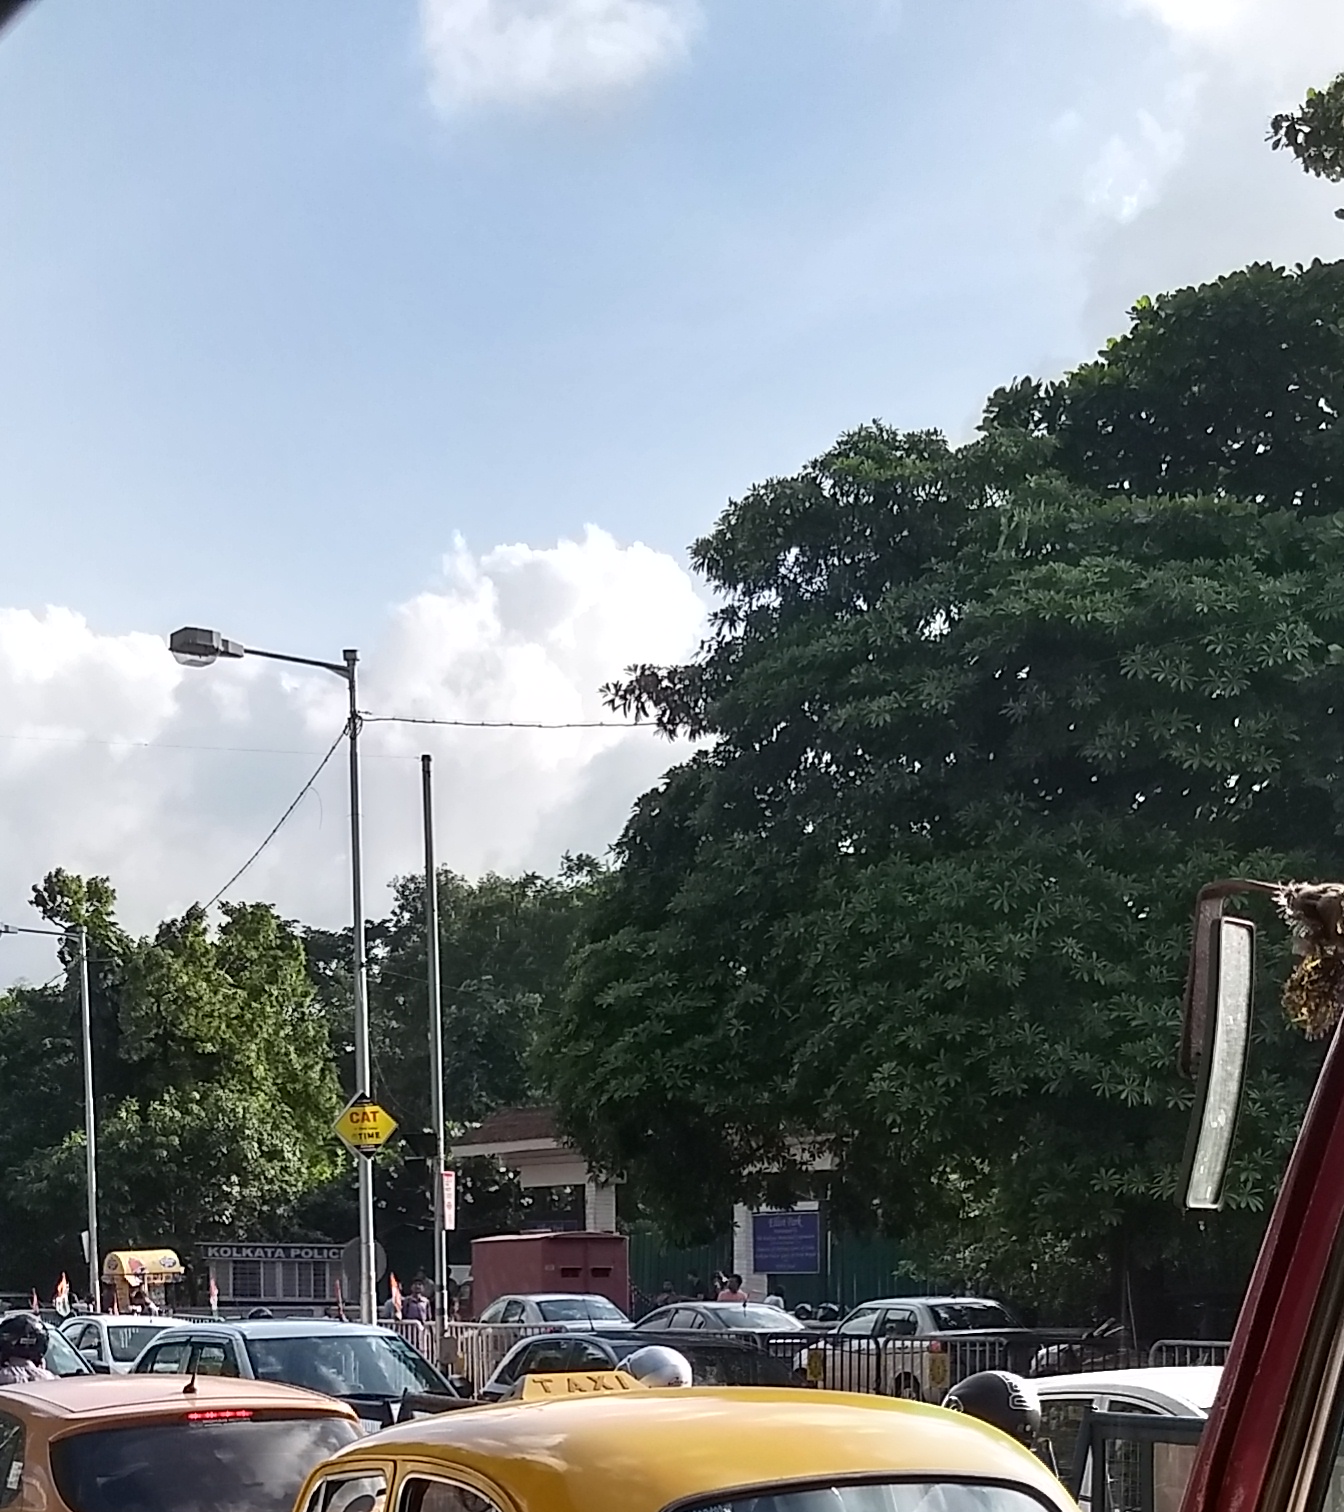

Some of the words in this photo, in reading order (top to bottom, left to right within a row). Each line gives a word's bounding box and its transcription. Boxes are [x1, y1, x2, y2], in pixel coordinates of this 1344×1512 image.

[349, 1110, 379, 1124] CAT
[207, 1246, 286, 1258] KOLKATA
[290, 1248, 344, 1259] POLIC
[531, 1375, 630, 1394] TAXI
